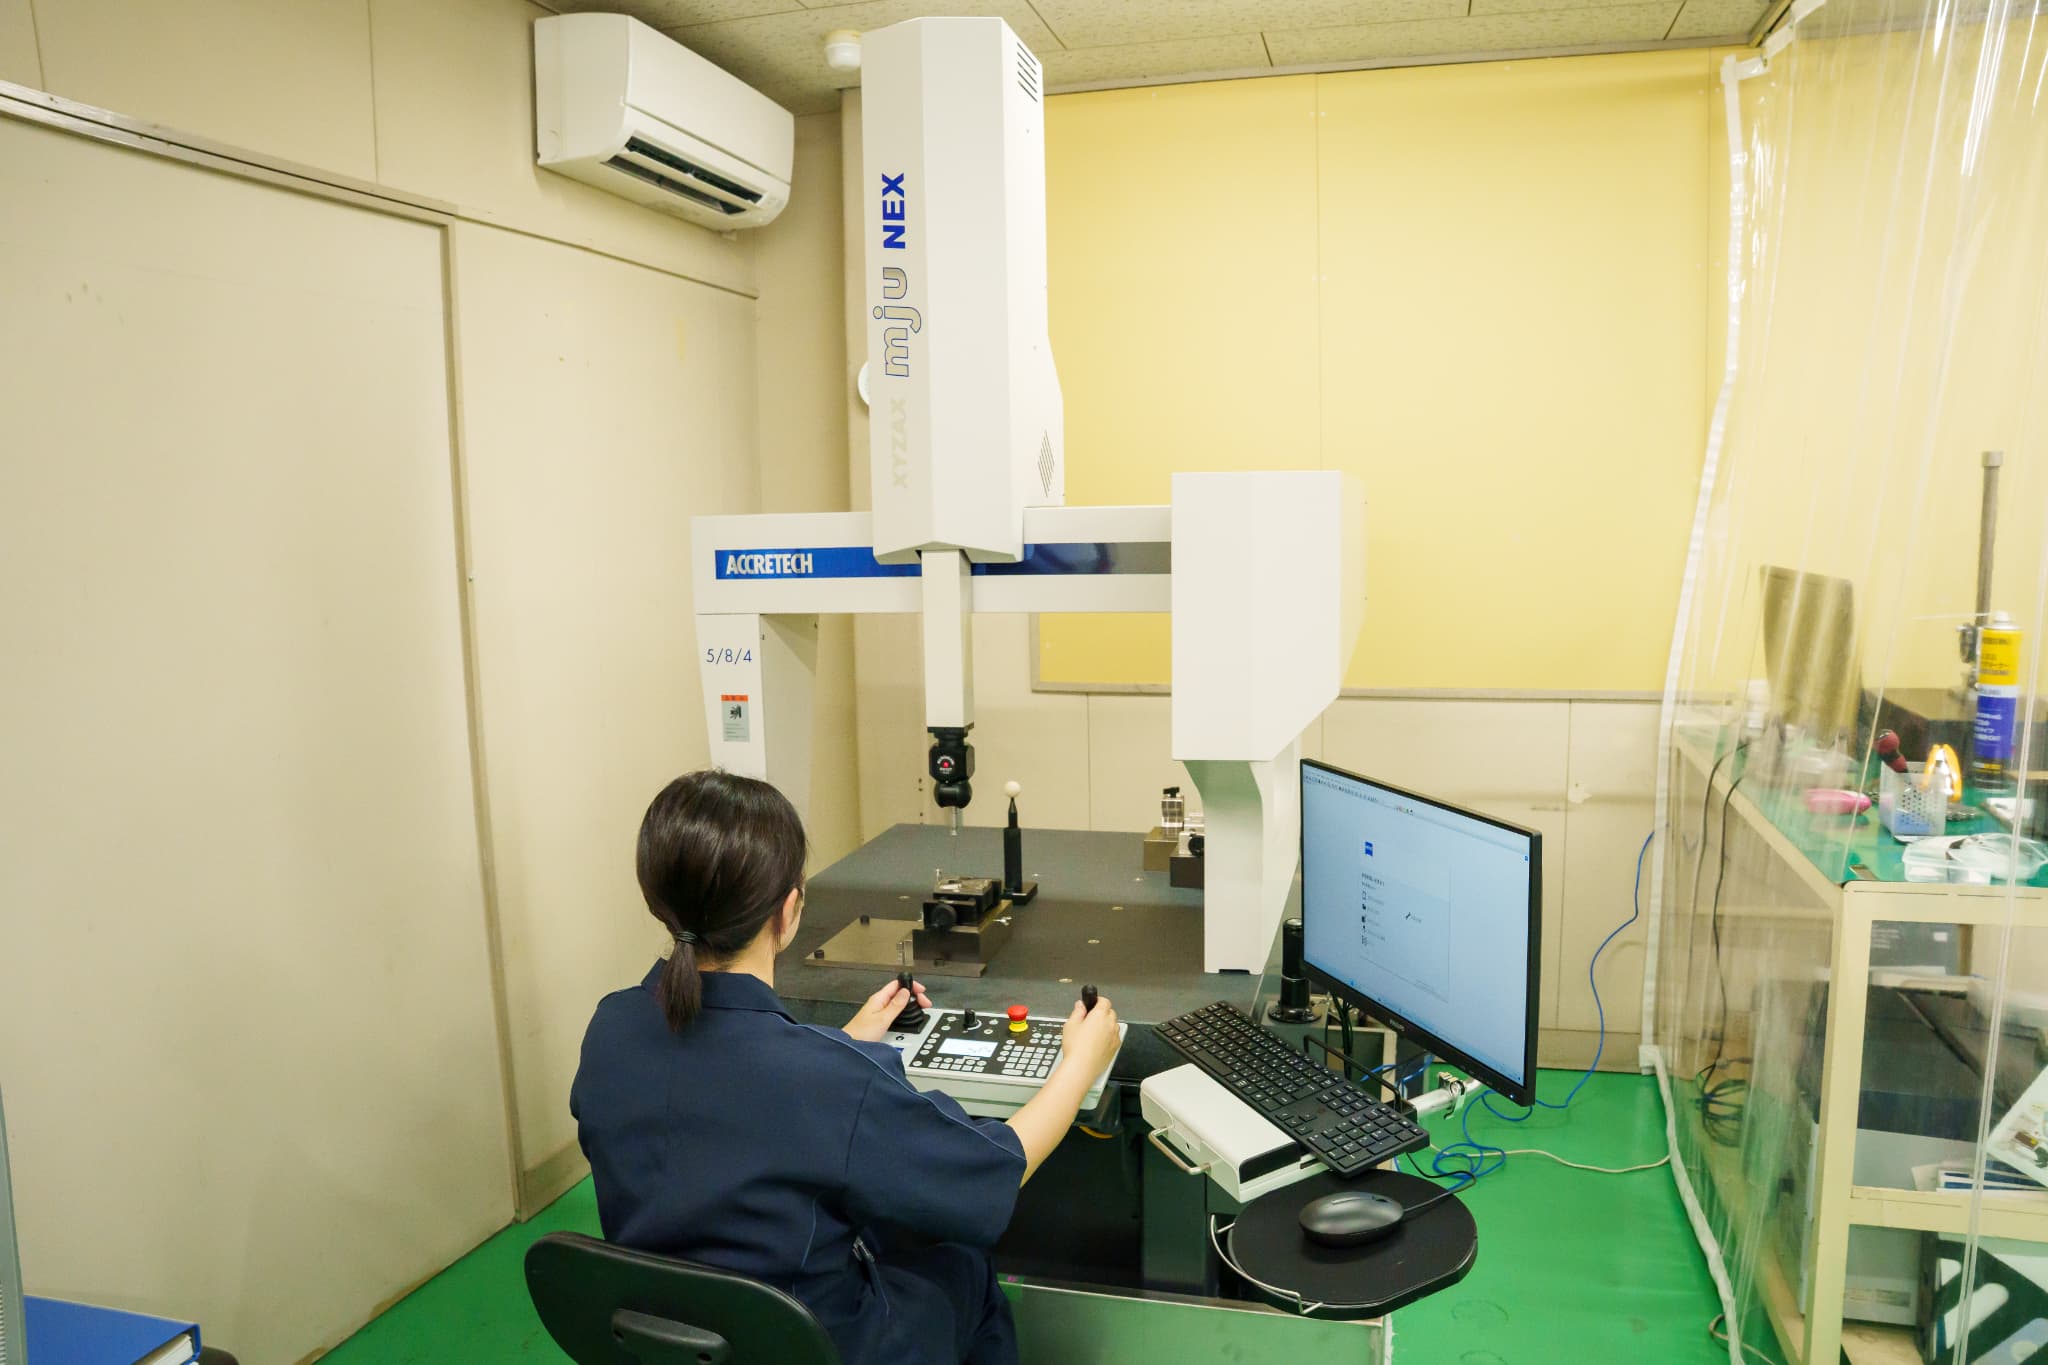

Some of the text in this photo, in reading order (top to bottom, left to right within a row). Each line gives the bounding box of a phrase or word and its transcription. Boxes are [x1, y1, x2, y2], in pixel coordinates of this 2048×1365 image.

[873, 173, 921, 489] XYZAX mju NEX
[727, 553, 813, 575] ACCRETECH
[706, 648, 752, 664] 5/8/4
